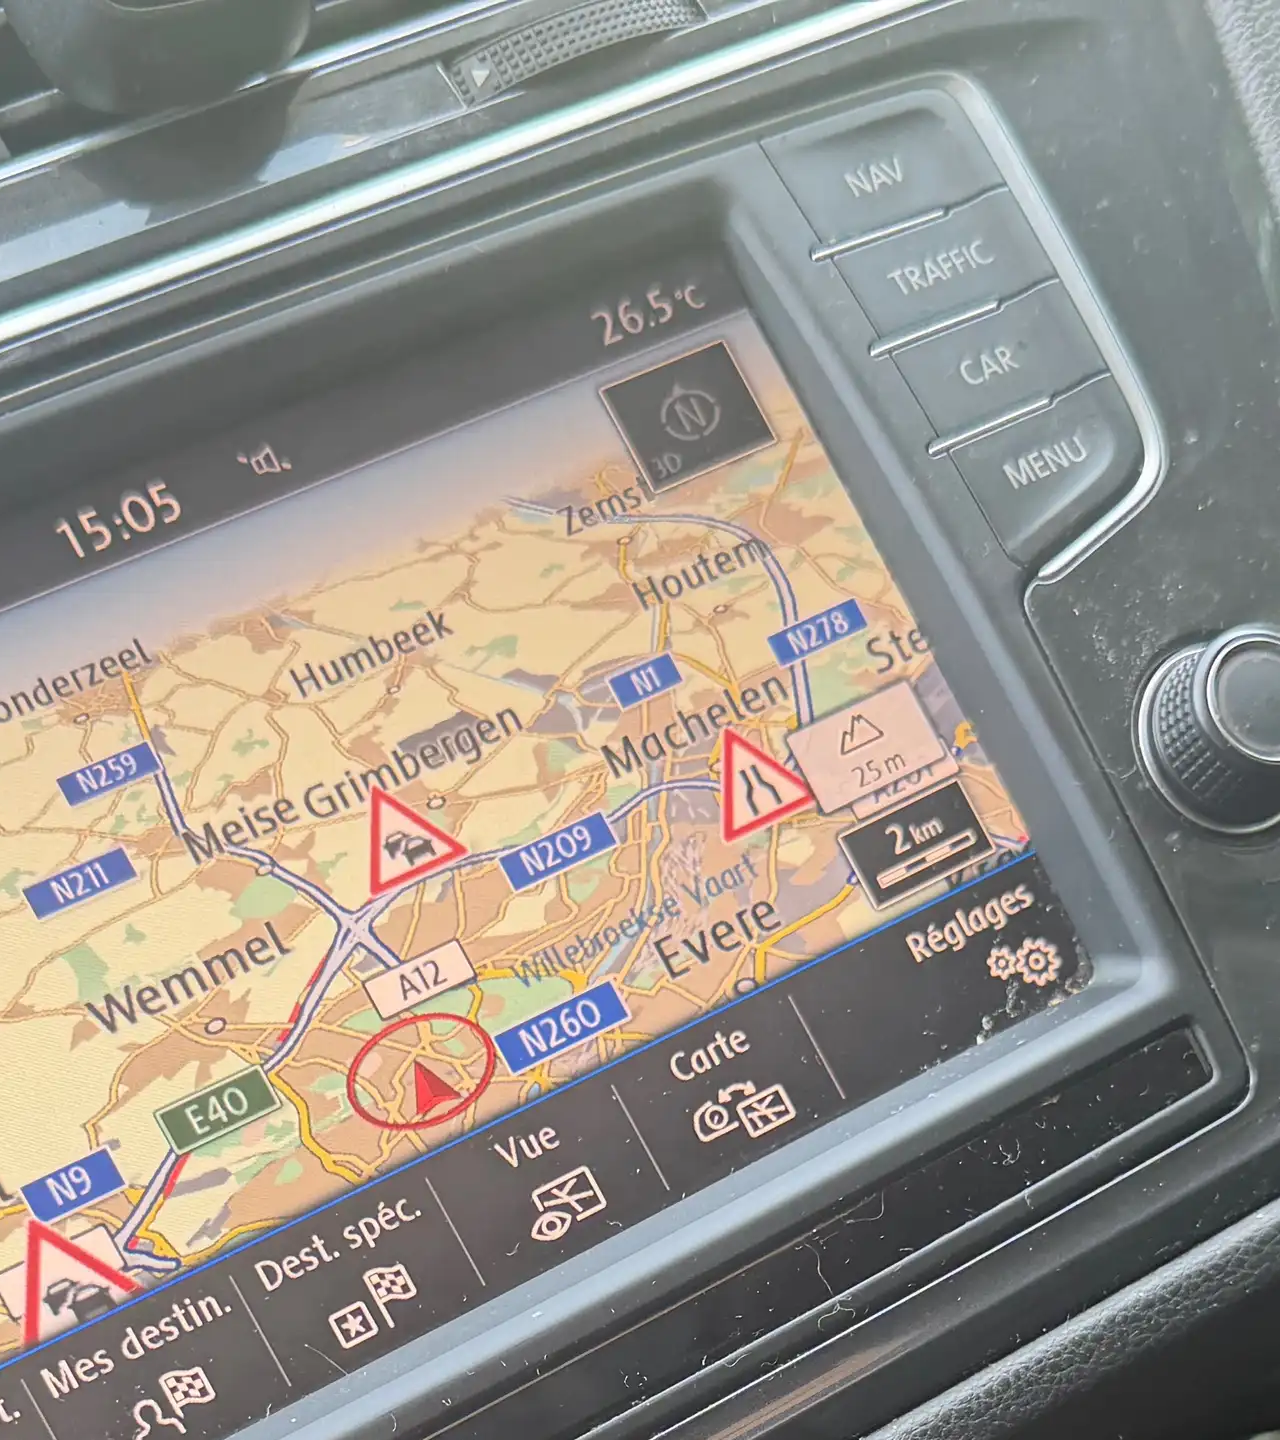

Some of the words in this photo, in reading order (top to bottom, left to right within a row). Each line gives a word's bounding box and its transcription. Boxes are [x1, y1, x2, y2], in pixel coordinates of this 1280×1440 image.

[843, 157, 905, 198] NAV
[886, 239, 996, 297] TRAFFIC
[959, 346, 1019, 386] CAR
[1001, 433, 1088, 490] MENU
[56, 481, 182, 559] 15:05
[289, 610, 455, 699] Humbeek
[786, 611, 850, 654] N278
[866, 624, 932, 674] Ste
[630, 666, 662, 696] N1
[600, 675, 790, 779] Machelen
[74, 751, 139, 795] N259
[303, 706, 523, 823] Grimbergen
[851, 760, 882, 788] 25
[884, 752, 906, 775] m
[180, 797, 301, 865] Meise
[518, 822, 594, 877] N209
[884, 823, 913, 855] 2
[908, 816, 944, 845] km
[49, 864, 112, 905] N211
[510, 895, 681, 988] Willebroekse
[681, 852, 760, 908] Vaart
[653, 899, 781, 980] Evere
[905, 882, 1035, 964] Réglages
[85, 921, 294, 1036] Wemmel
[396, 958, 451, 1002] A12
[517, 998, 602, 1059] N260
[669, 1026, 751, 1082] Carte
[183, 1086, 249, 1136] E40
[493, 1123, 561, 1169] Vue
[45, 1165, 93, 1208] N9
[253, 1232, 340, 1293] Dest.
[342, 1194, 423, 1252] spéc.
[40, 1346, 116, 1400] Mes
[120, 1290, 233, 1361] destin.
